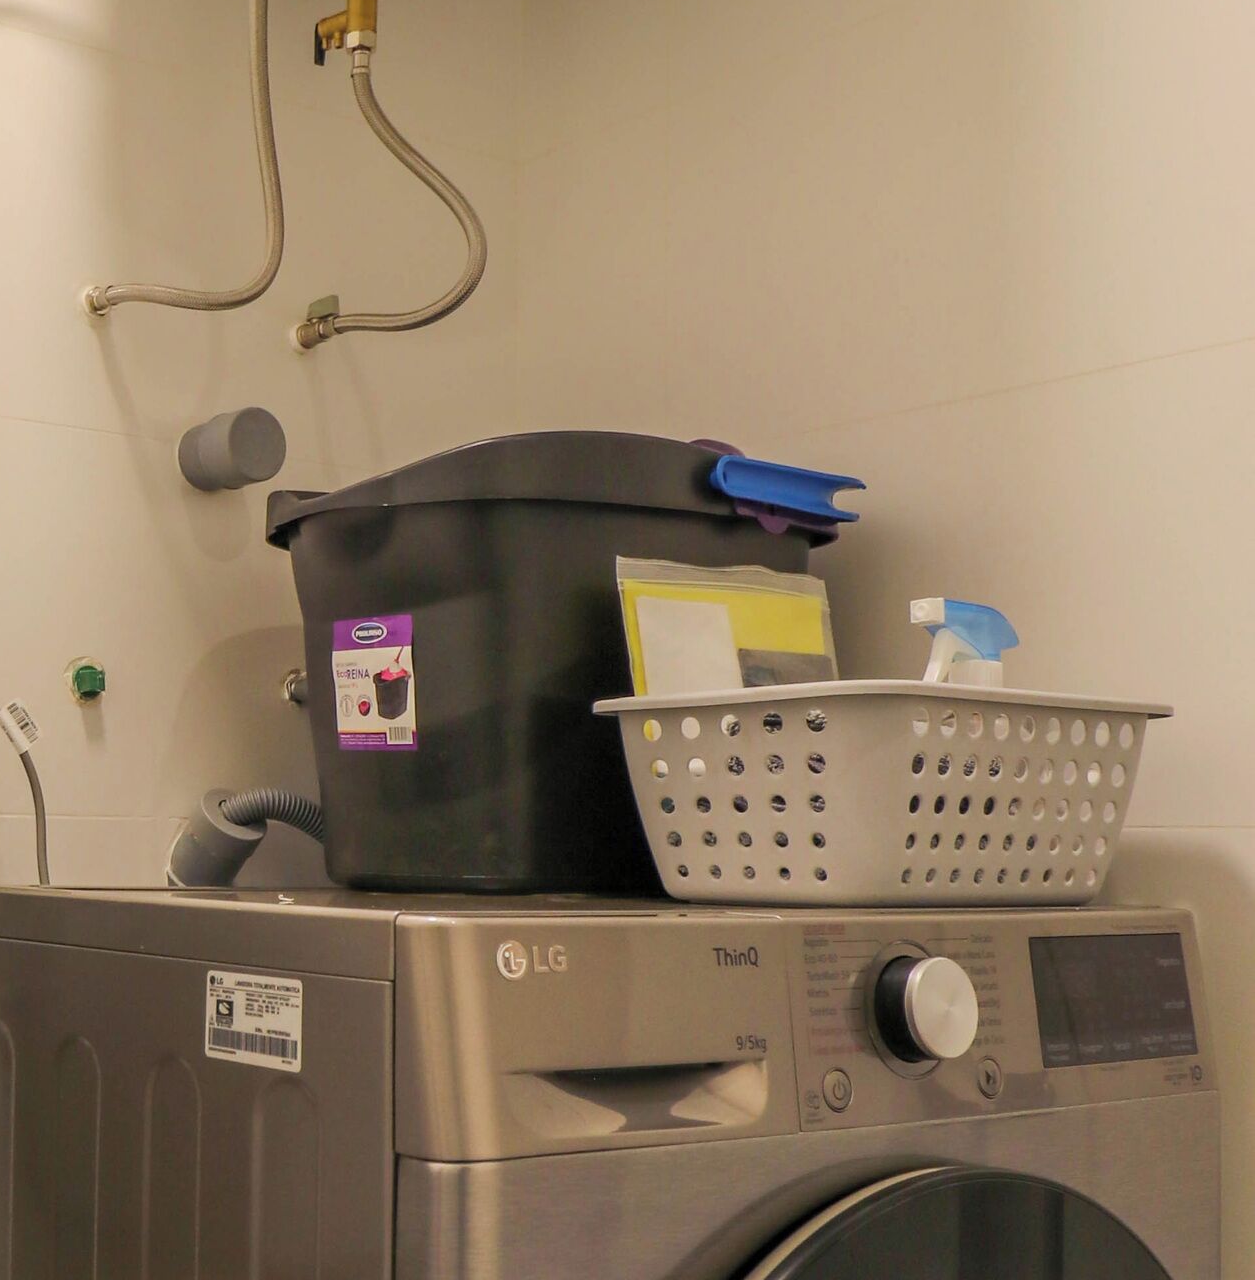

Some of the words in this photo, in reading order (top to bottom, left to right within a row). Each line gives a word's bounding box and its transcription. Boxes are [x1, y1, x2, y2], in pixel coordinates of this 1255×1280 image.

[531, 944, 568, 973] LG
[712, 946, 759, 968] ThinQ
[736, 1035, 767, 1053] 9/5kg
